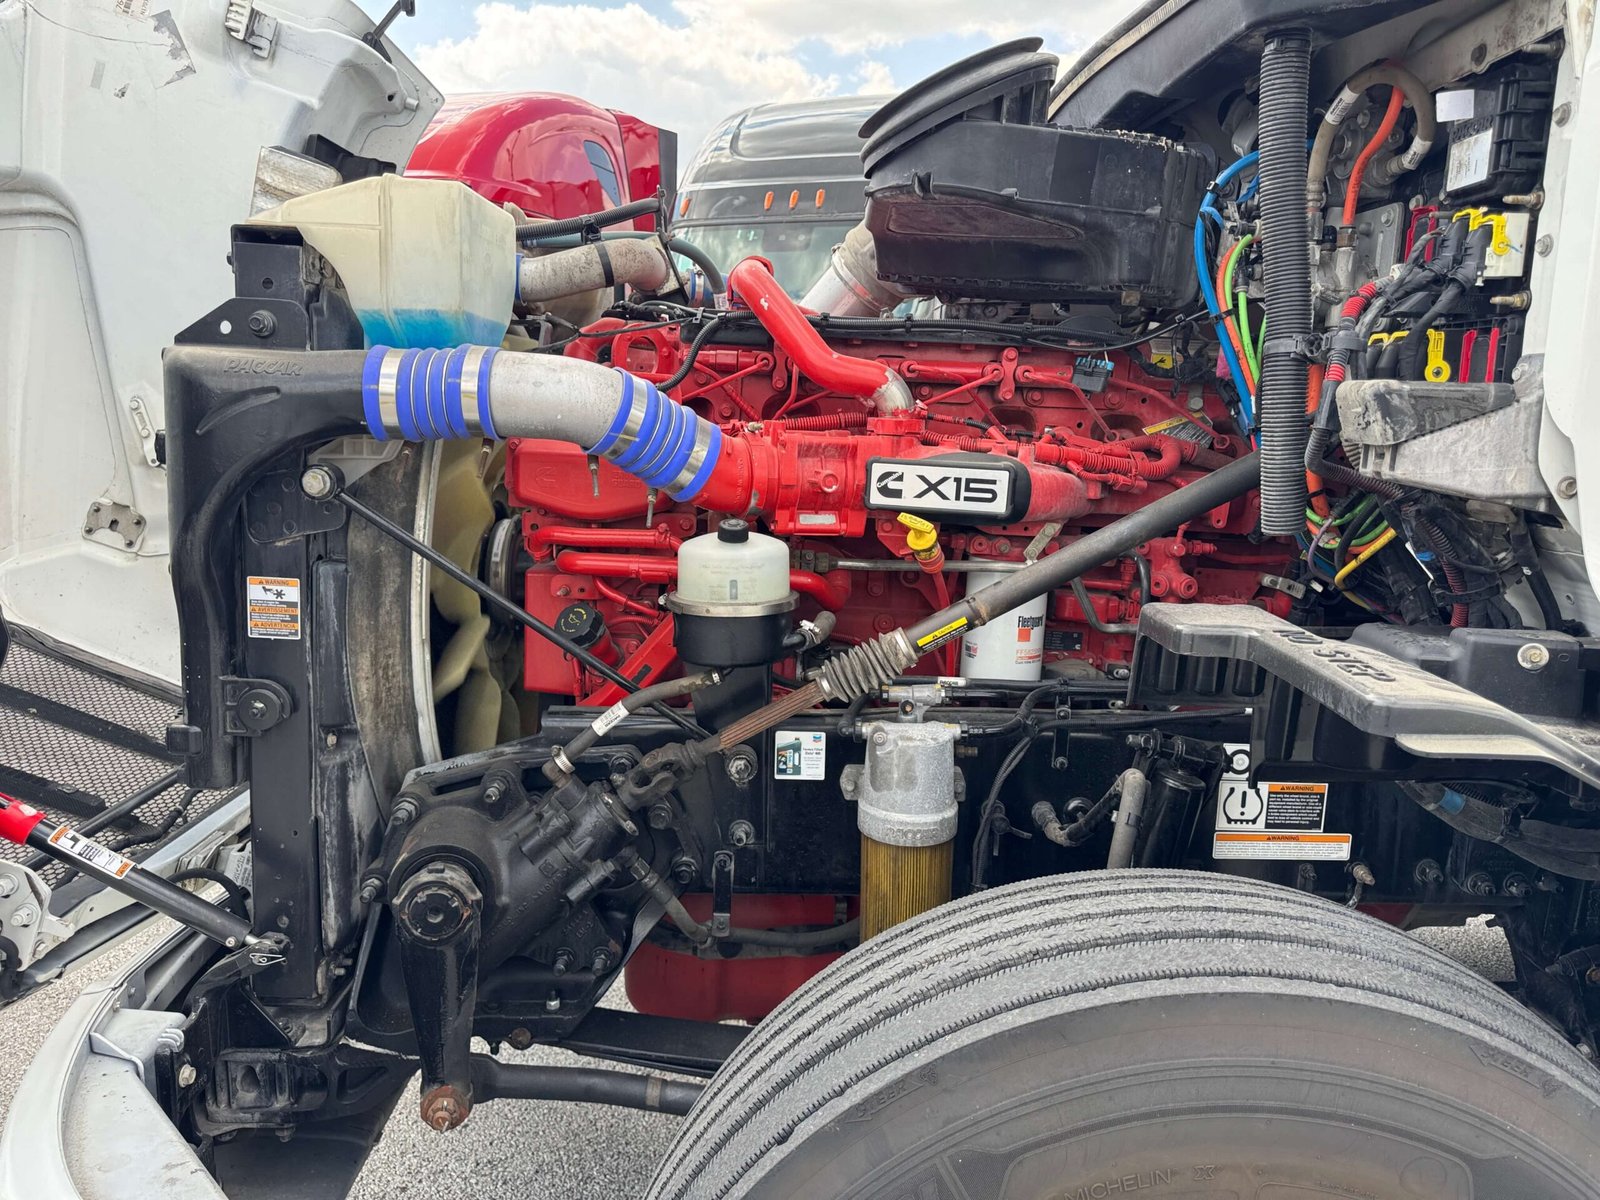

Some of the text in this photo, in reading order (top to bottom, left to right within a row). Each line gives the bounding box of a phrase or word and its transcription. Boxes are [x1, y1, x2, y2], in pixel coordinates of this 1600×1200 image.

[224, 359, 304, 377] PACCAR
[876, 471, 902, 488] Cummins
[913, 474, 998, 503] X15
[1272, 630, 1323, 644] NO
[1313, 649, 1396, 682] STEP
[1064, 1168, 1172, 1200] MICHELIN
